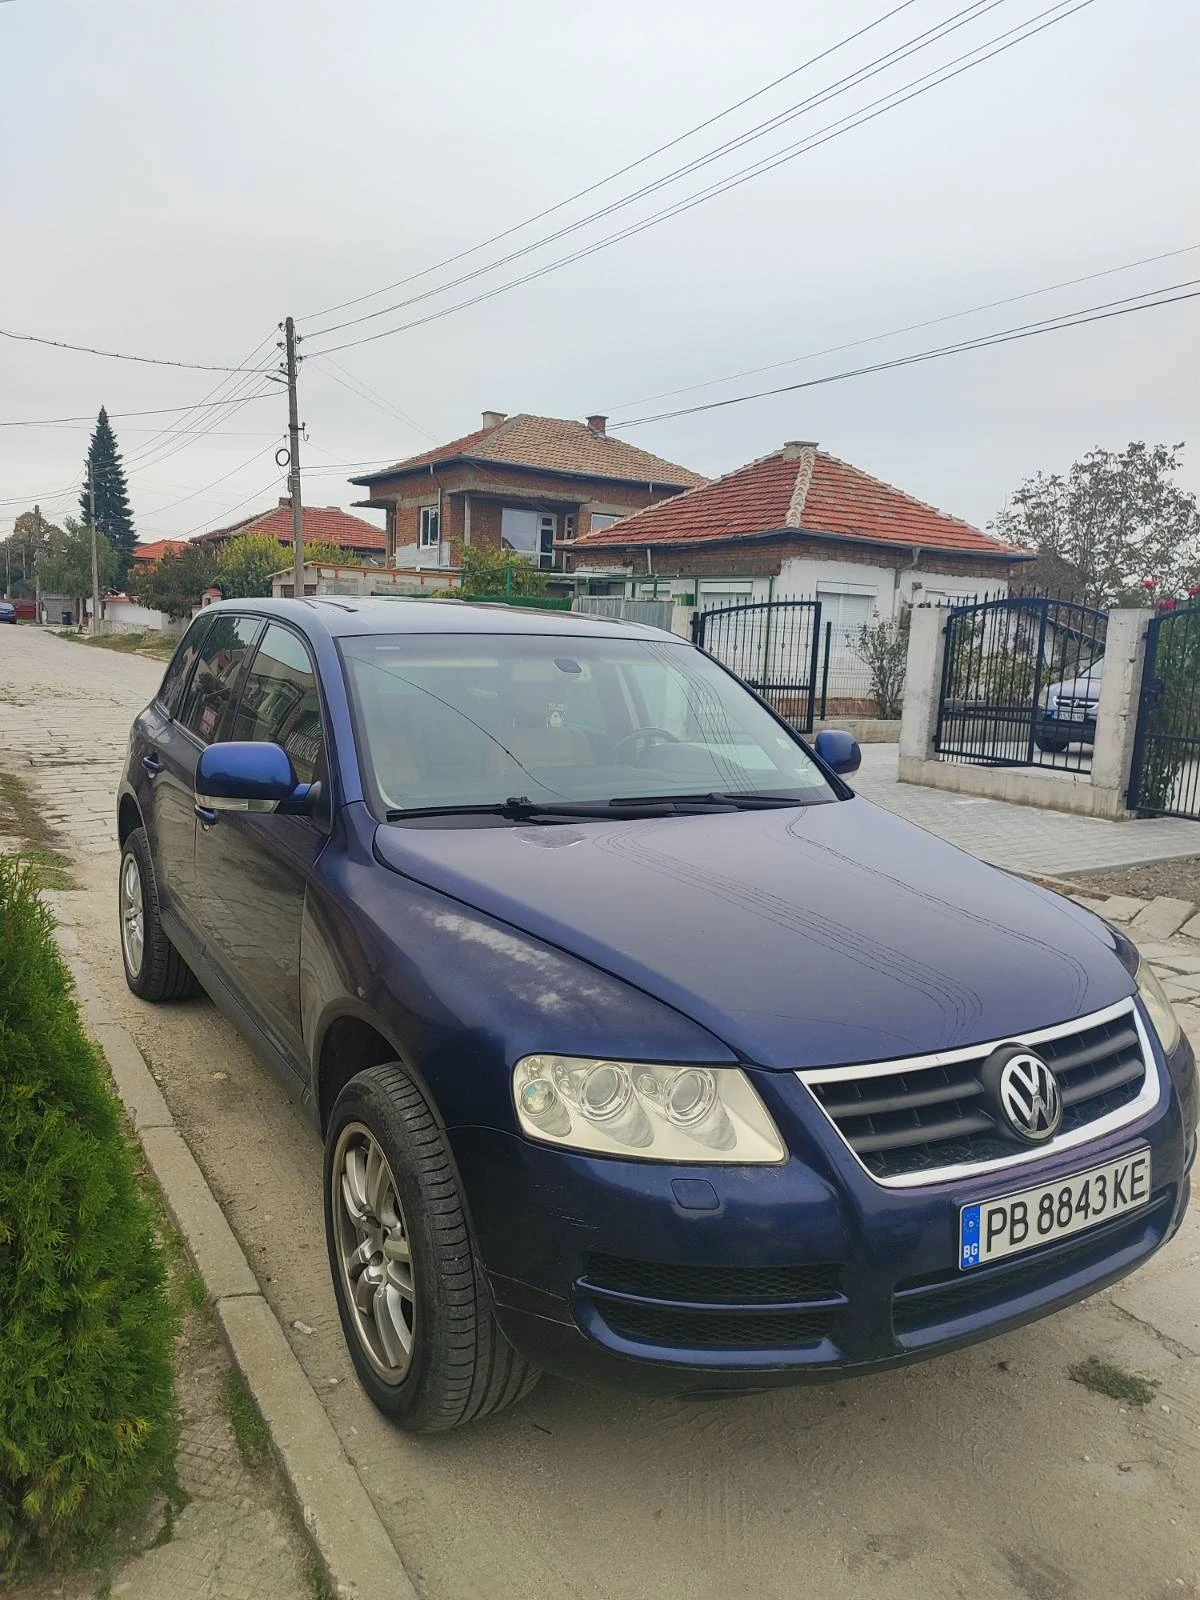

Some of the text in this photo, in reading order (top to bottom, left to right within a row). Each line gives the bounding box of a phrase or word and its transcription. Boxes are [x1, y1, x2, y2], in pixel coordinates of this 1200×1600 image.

[1002, 1056, 1058, 1137] VW
[986, 1158, 1146, 1253] PB 8843 KE
[963, 1243, 978, 1258] BG
